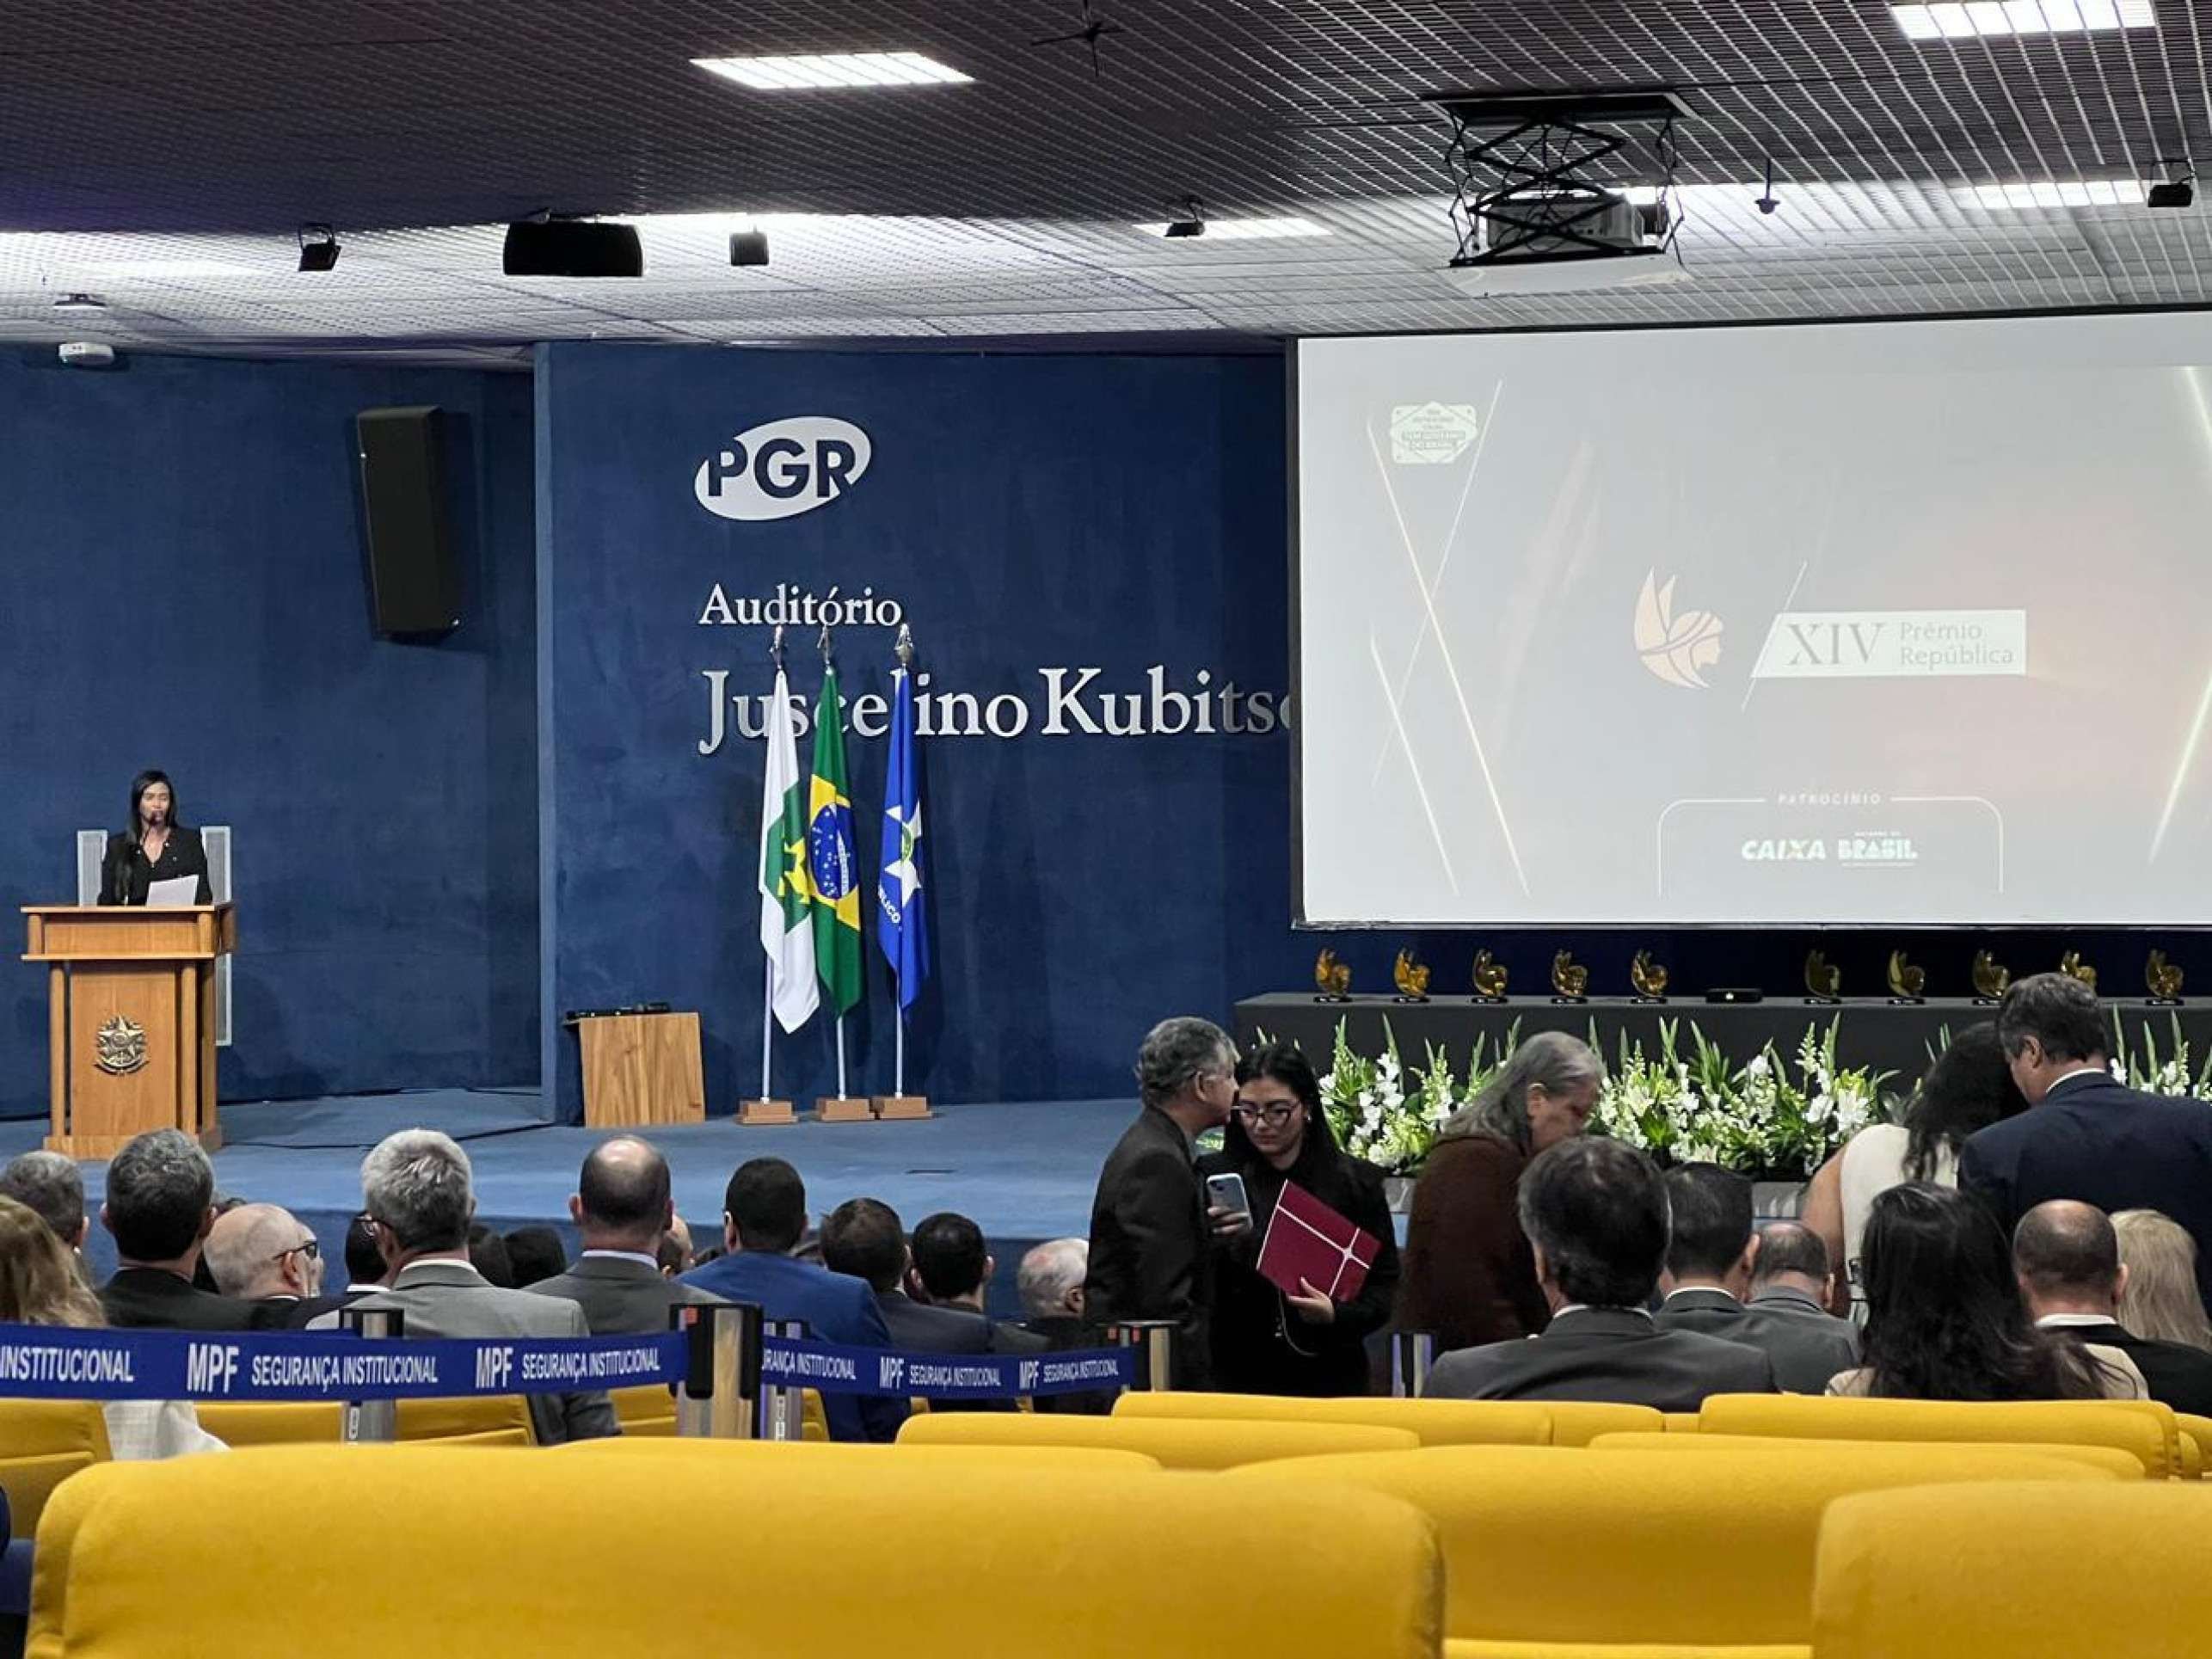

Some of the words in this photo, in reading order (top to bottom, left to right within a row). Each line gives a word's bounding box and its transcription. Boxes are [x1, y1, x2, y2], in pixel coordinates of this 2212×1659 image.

[708, 437, 852, 499] PGR
[698, 583, 902, 626] Auditório
[1785, 622, 1889, 666] XIV
[1900, 620, 1983, 642] Prêmio
[1900, 645, 2013, 672] República
[698, 667, 1029, 755] Juseino
[1741, 839, 1827, 861] CAIXA
[1837, 839, 1919, 860] BRASIL
[0, 1345, 134, 1382] INSTITUCIONAL
[187, 1343, 240, 1393] MPF
[251, 1355, 340, 1392] SEGURANÇA
[343, 1355, 439, 1383] INSTITUCIONAL
[475, 1347, 513, 1388] MPF
[521, 1353, 587, 1383] SEGURANÇA
[589, 1348, 661, 1377] INSTITUCIONAL
[796, 1352, 857, 1380] INSTITUCIONAL
[879, 1355, 904, 1390] MPF
[1018, 1360, 1040, 1390] MPF
